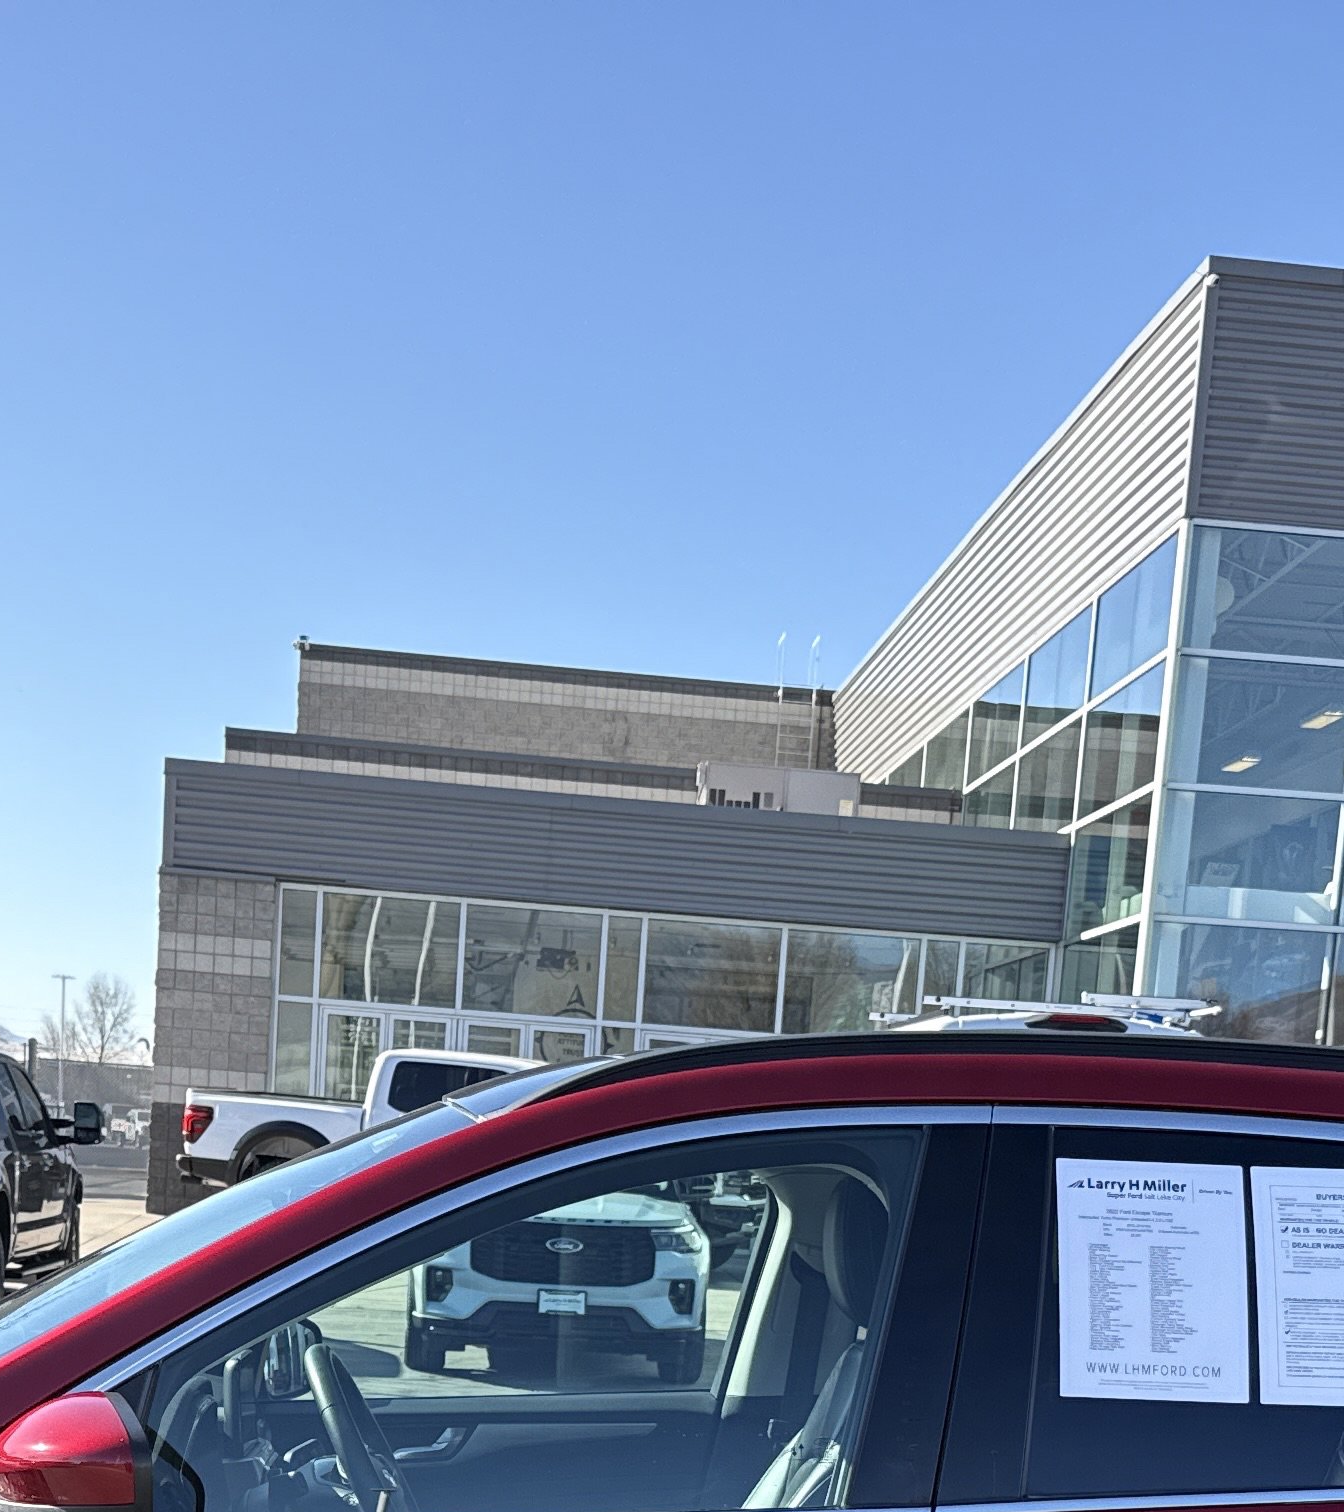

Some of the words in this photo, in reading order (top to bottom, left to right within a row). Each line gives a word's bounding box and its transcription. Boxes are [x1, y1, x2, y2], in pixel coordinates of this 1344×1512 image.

[1087, 1178, 1125, 1192] Larry
[1128, 1180, 1140, 1191] H
[1143, 1180, 1187, 1193] Miller
